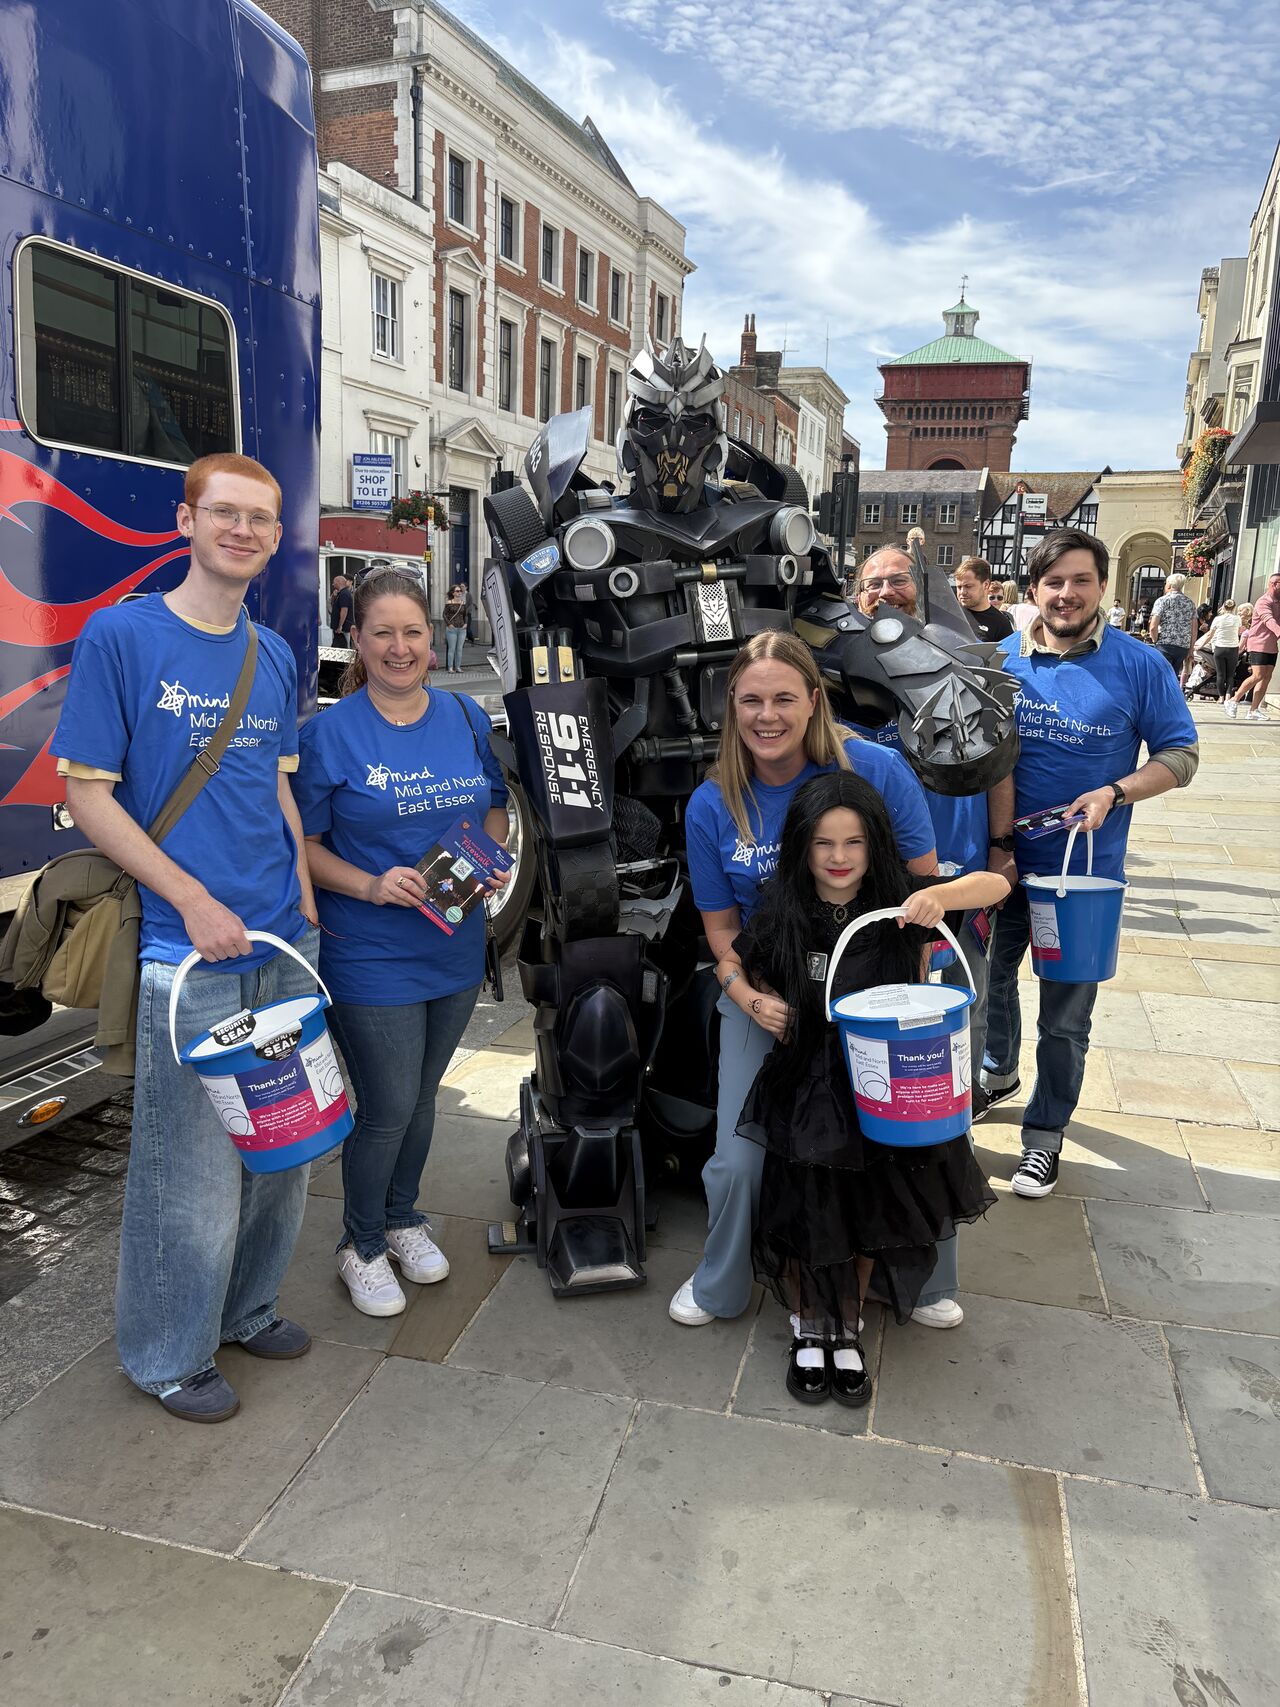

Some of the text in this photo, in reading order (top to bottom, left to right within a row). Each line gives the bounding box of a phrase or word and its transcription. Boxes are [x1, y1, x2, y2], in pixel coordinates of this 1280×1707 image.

[360, 475, 385, 484] SHOP
[356, 487, 388, 496] TO LET
[188, 692, 230, 708] mind
[1022, 699, 1060, 712] mind
[190, 713, 216, 728] Mid
[248, 714, 278, 731] North
[1020, 712, 1111, 736] Mid and North
[189, 733, 212, 747] Eas
[877, 732, 899, 743] Eas
[1019, 725, 1084, 745] East Essex
[534, 711, 562, 804] RESPONSE
[548, 712, 592, 808] 9-1-1
[578, 716, 604, 812] EMERGENCY
[391, 766, 434, 782] mind
[394, 774, 487, 798] Mid and North
[397, 794, 475, 816] East Essex
[462, 840, 489, 867] Firewalk
[216, 1015, 249, 1036] SECURITY
[221, 1024, 252, 1044] SEAL
[264, 1037, 297, 1057] SEAL
[927, 1049, 944, 1061] you!
[248, 1078, 276, 1092] Thank
[278, 1067, 297, 1085] you!
